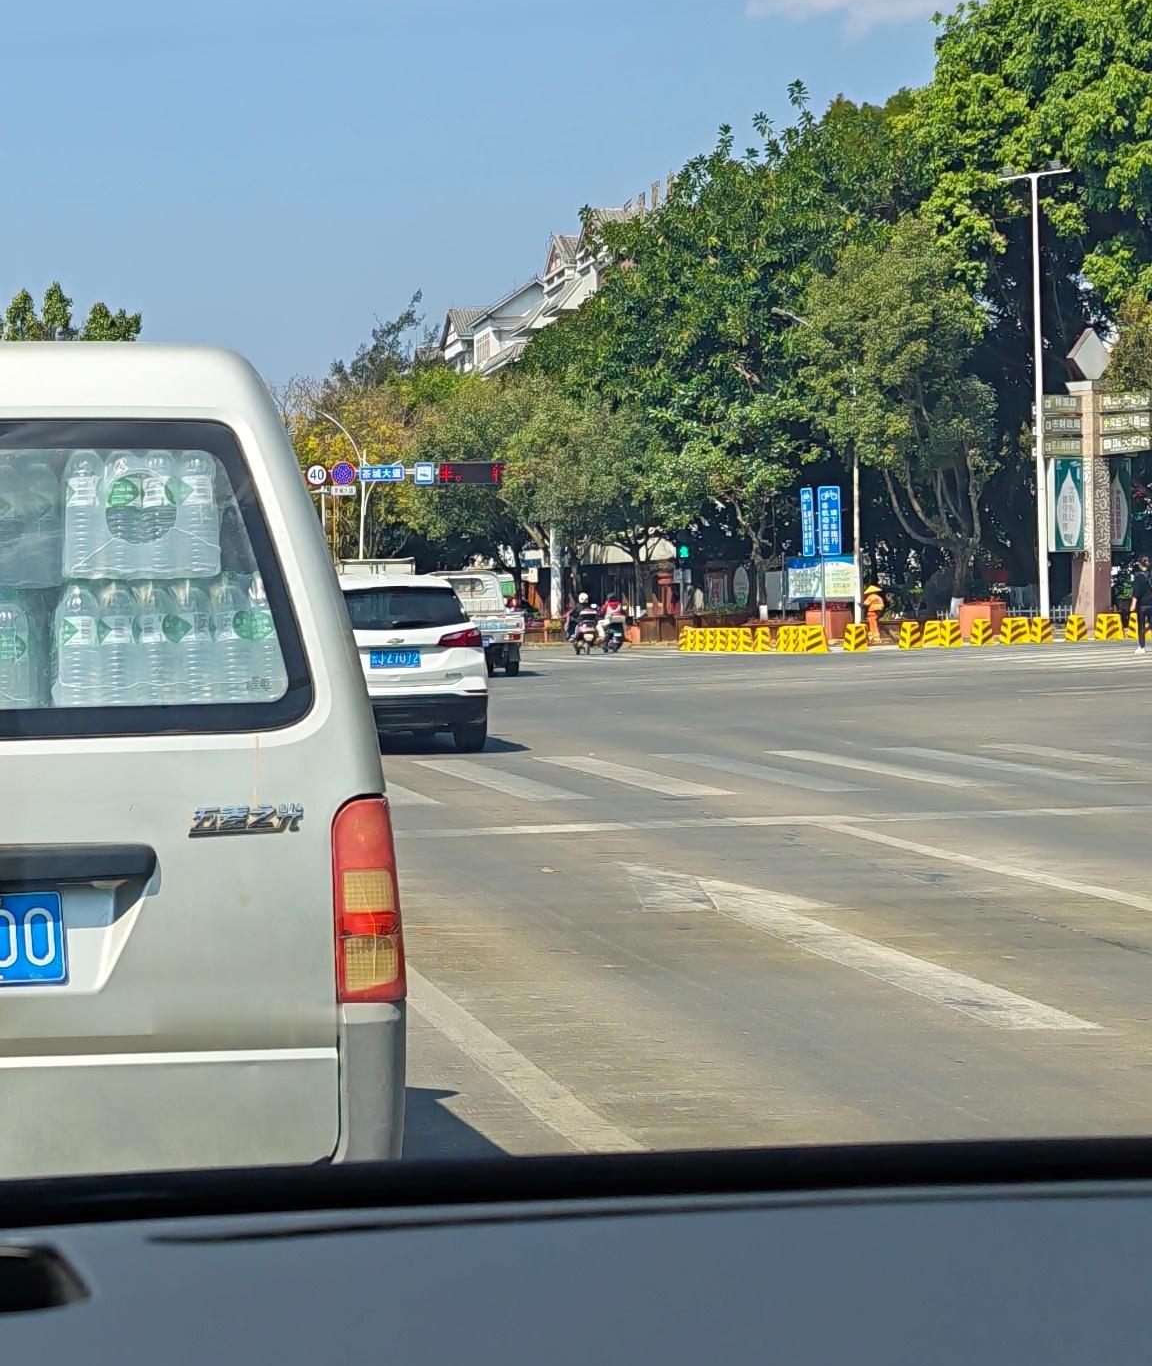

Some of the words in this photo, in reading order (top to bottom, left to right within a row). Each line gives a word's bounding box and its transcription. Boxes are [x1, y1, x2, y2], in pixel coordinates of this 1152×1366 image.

[309, 467, 325, 482] 40
[361, 468, 402, 479] 茶城大道
[188, 803, 304, 838] 五菱之光
